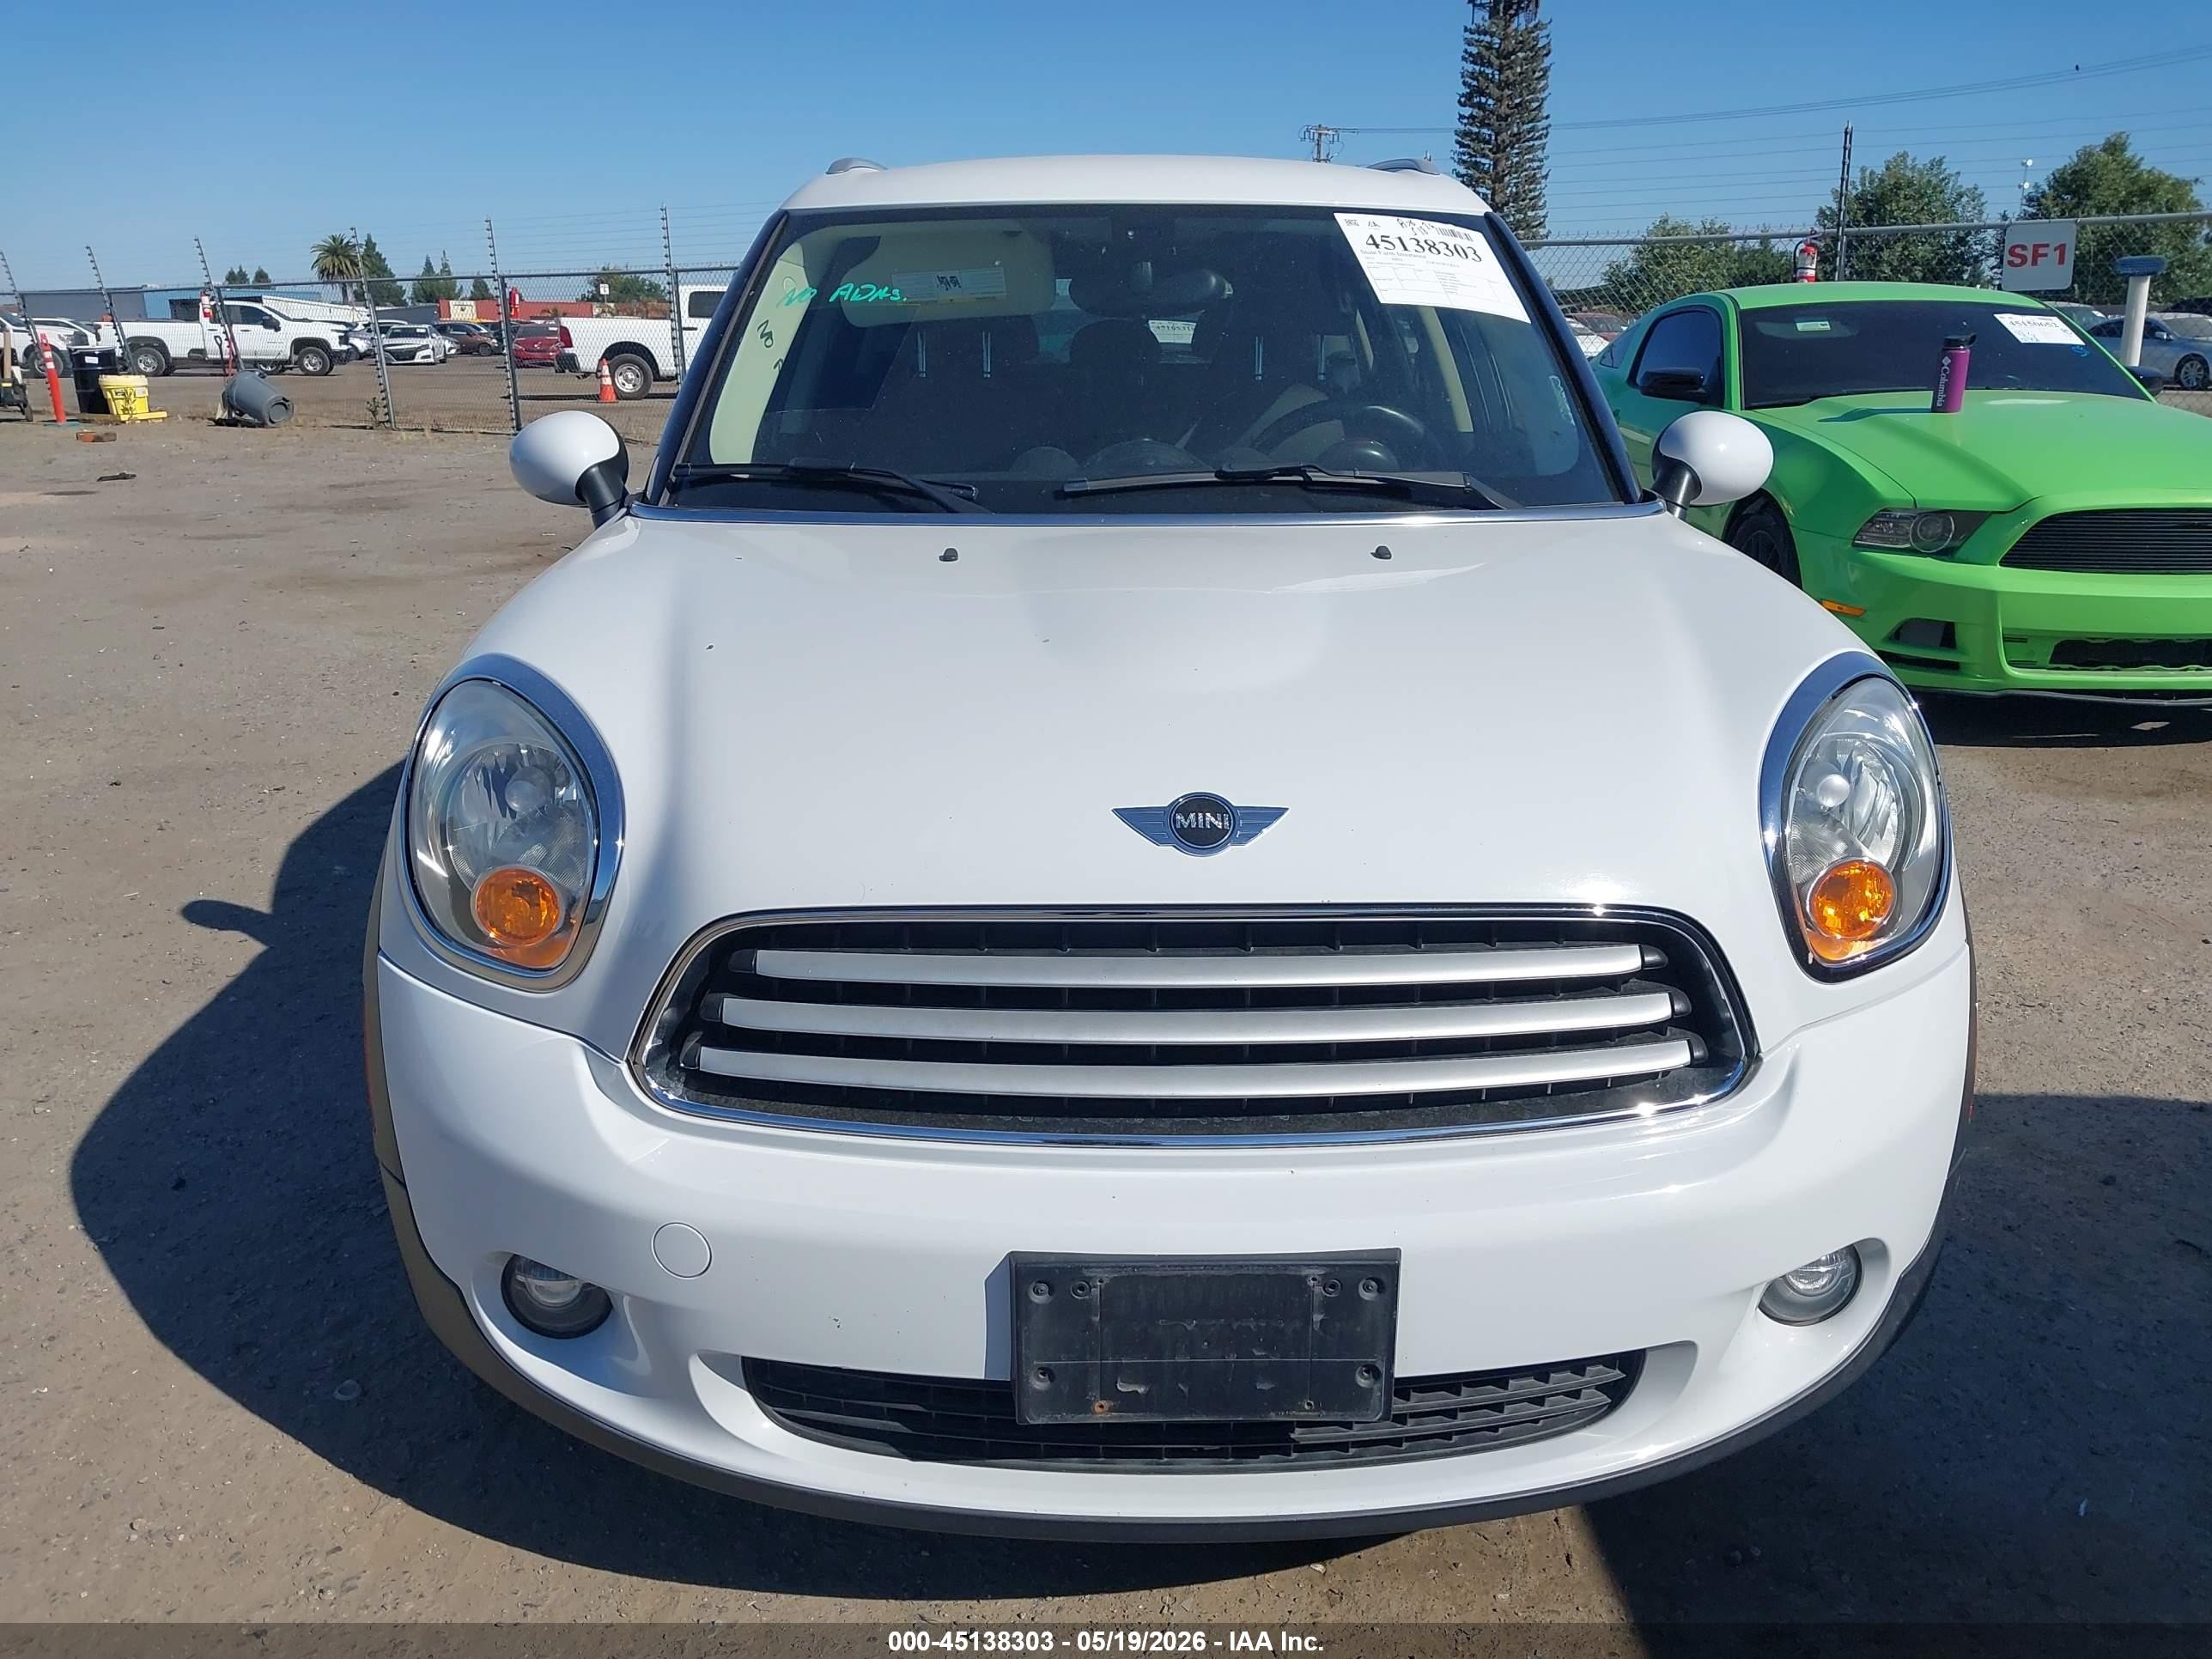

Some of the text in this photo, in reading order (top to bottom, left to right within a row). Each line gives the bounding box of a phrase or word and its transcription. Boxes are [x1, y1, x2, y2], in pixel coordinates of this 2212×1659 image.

[1365, 233, 1482, 263] 45138303
[2007, 242, 2067, 268] SF1
[1936, 366, 1950, 407] Columbia
[1175, 812, 1230, 830] MINI
